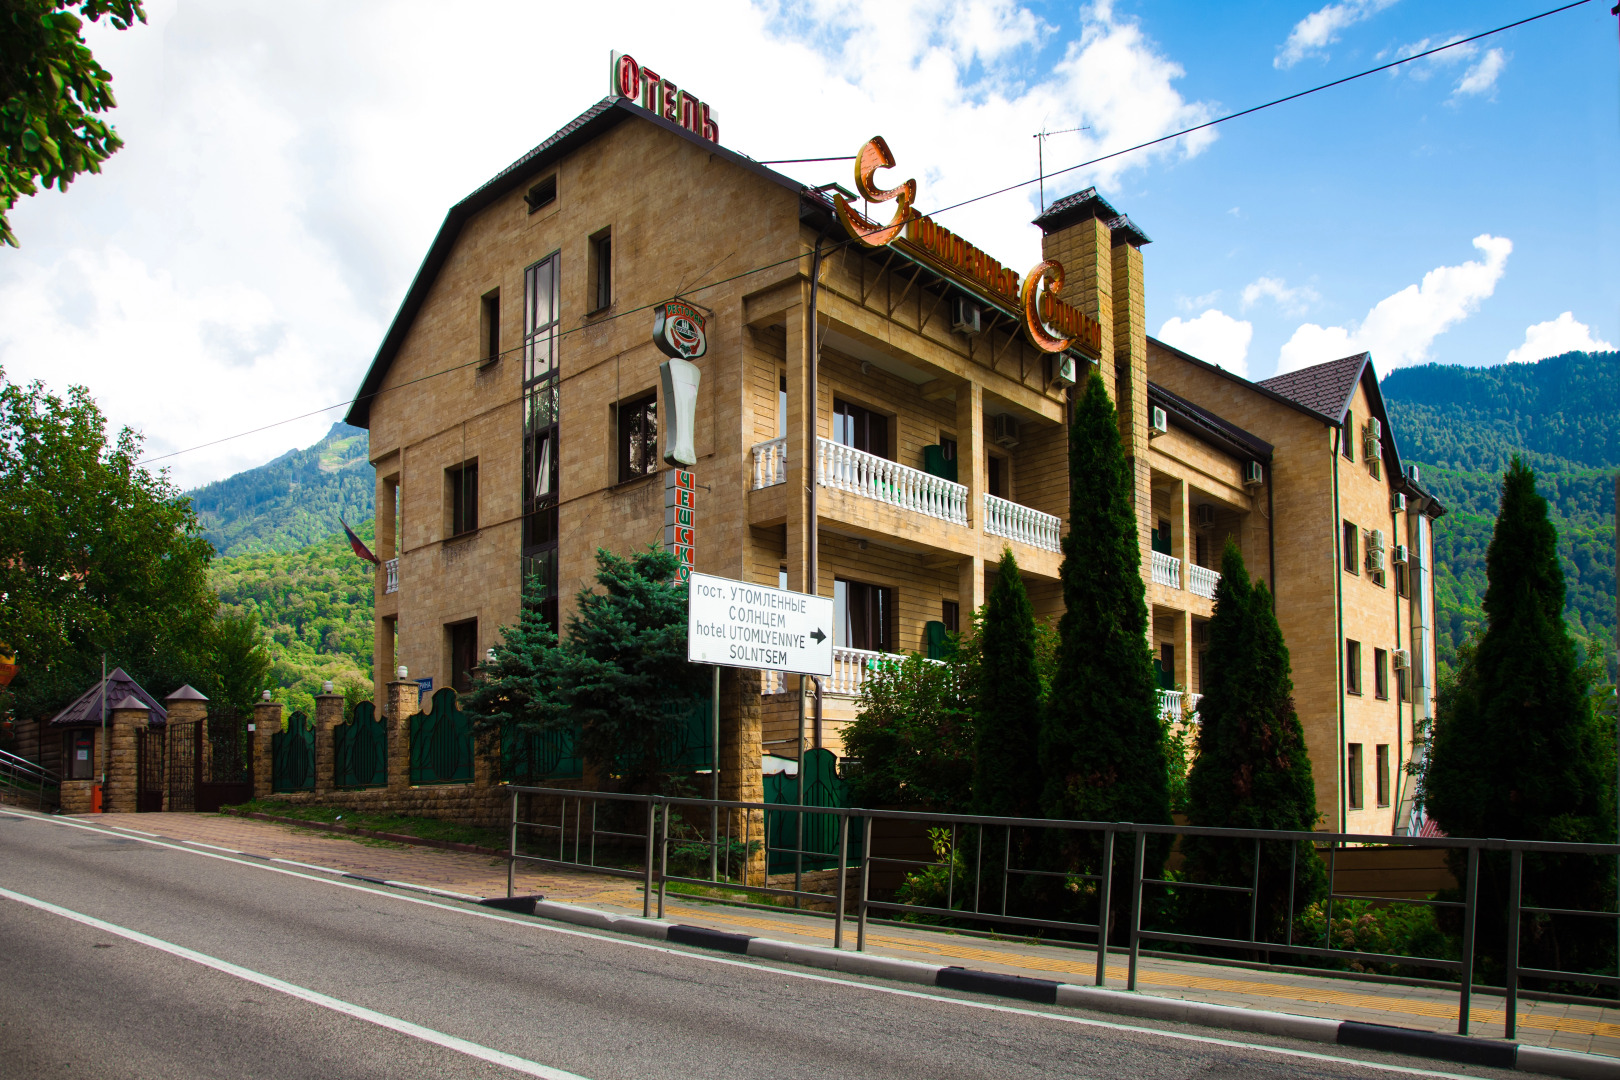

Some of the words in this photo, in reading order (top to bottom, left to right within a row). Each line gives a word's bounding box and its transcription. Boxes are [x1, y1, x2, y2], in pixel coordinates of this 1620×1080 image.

[614, 54, 720, 144] ОТЕЛЬ
[666, 304, 704, 327] РЕСТОРАН
[730, 586, 807, 614] УТОМЛЕННЫЕ
[729, 605, 786, 629] СОЛНЦЕМ
[696, 620, 726, 639] hotel
[729, 625, 806, 649] UTOMLYENNYE
[729, 644, 788, 665] SOLNTSEM
